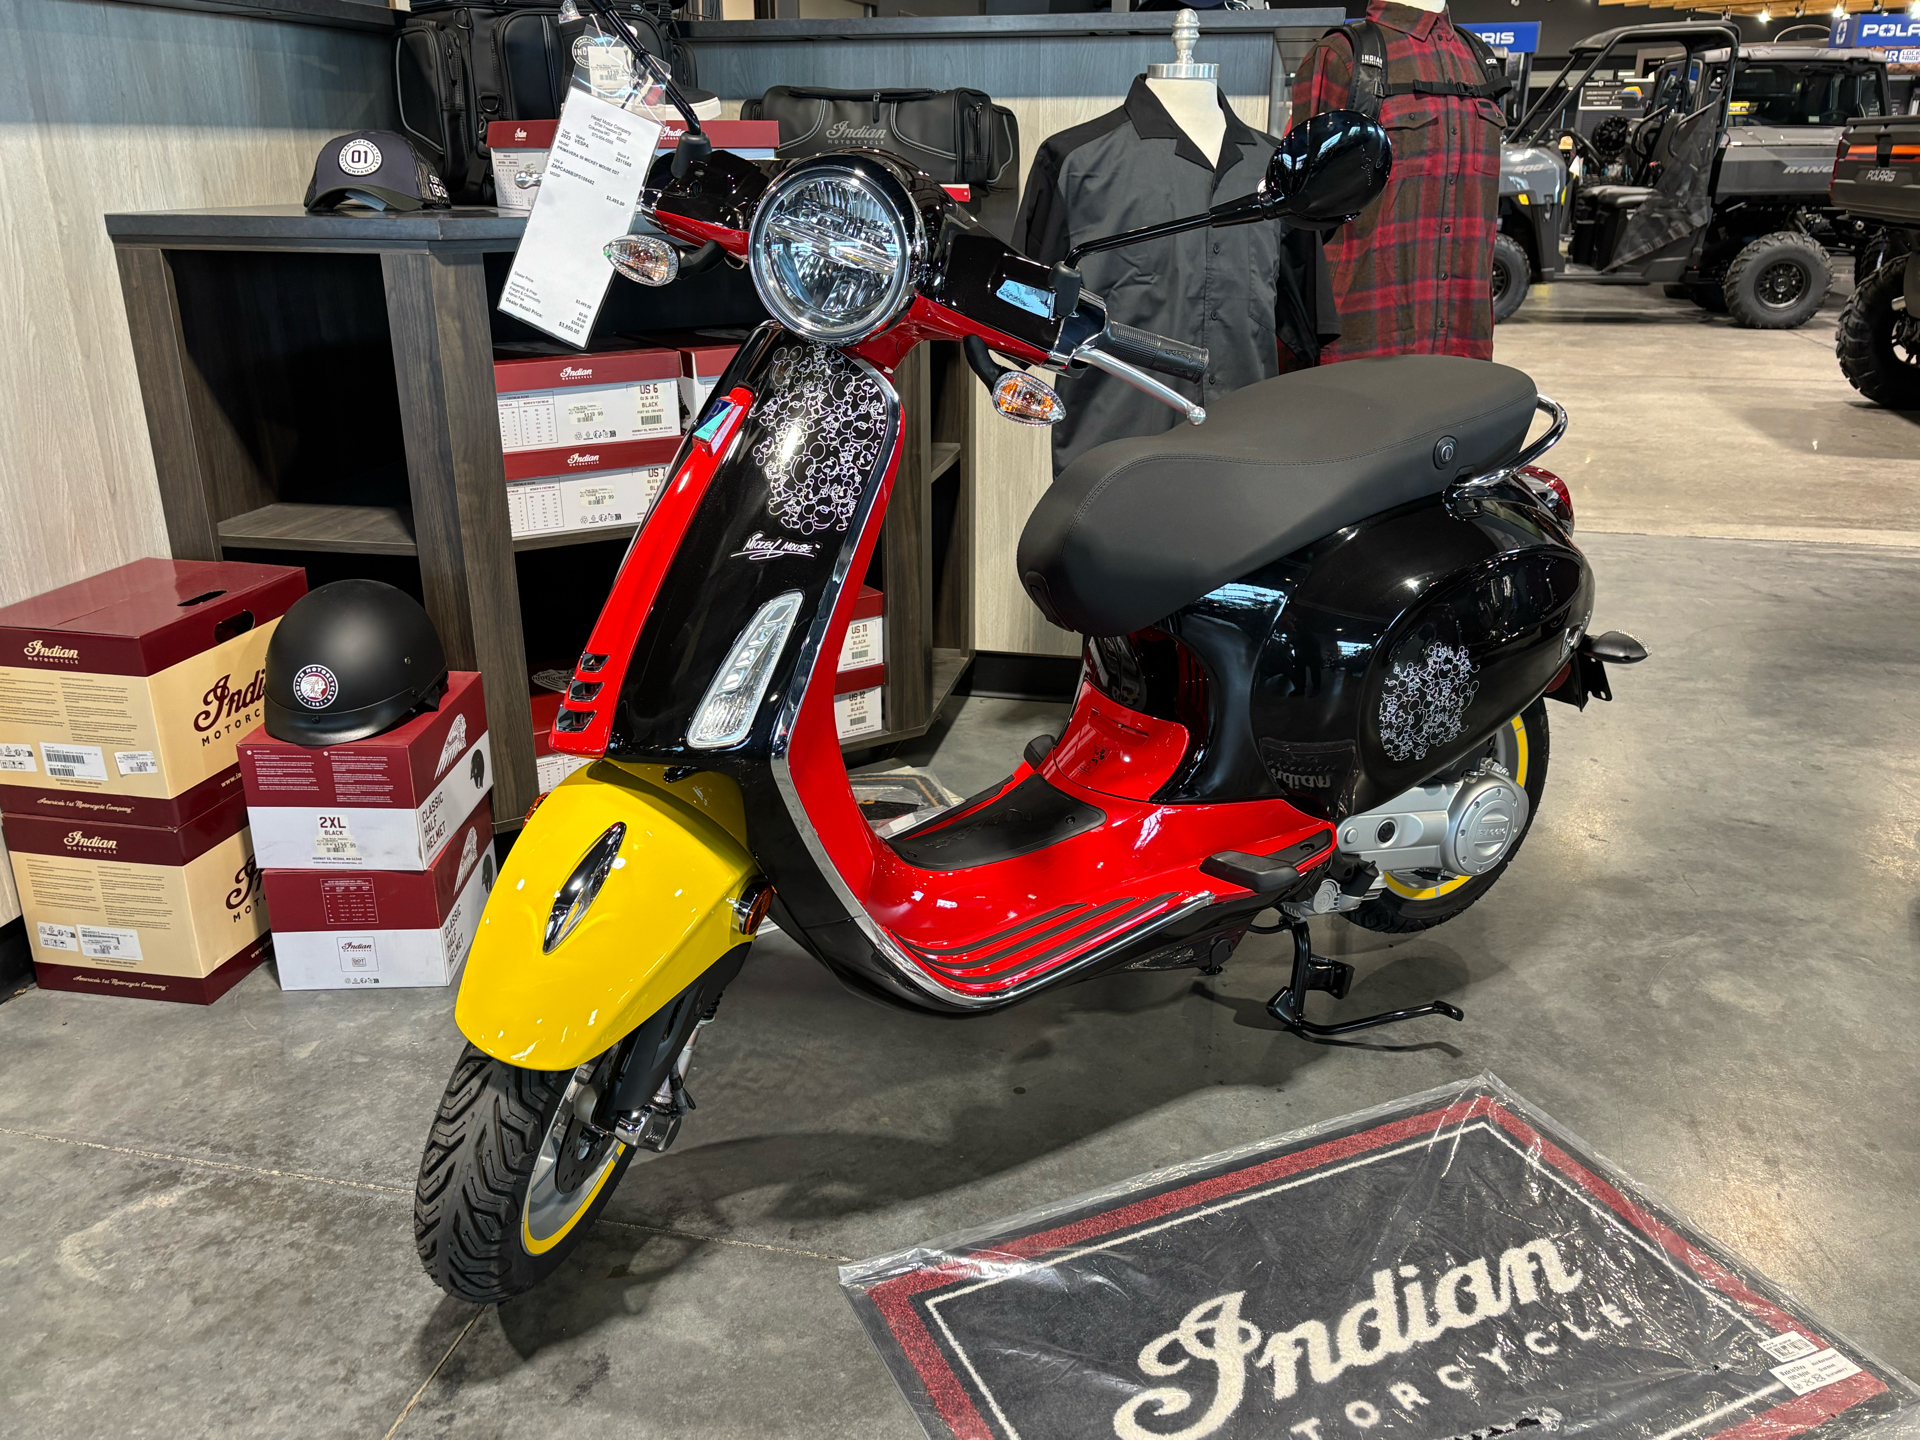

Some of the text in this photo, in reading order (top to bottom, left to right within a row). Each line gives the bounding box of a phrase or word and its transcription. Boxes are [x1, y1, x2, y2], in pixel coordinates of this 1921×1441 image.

[612, 124, 631, 136] Company
[826, 120, 887, 139] Indian
[558, 139, 569, 147] Model
[574, 138, 589, 148] VESPA
[351, 150, 368, 164] 01
[556, 145, 578, 157] PRIMAVERA
[583, 157, 598, 166] MICKEY
[598, 163, 611, 172] MOUSE
[1865, 169, 1897, 183] POLARIS
[505, 297, 518, 306] Dealer
[518, 303, 531, 312] Retail
[560, 366, 593, 378] Indian
[640, 384, 658, 394] US 6
[567, 453, 600, 463] Indian
[648, 468, 659, 477] US
[852, 624, 867, 634] US 11
[24, 640, 78, 659] Indian
[306, 667, 335, 699] MOTORCYCLE
[860, 691, 865, 699] 12
[421, 791, 444, 824] CLASSIC
[319, 817, 346, 828] 2XL
[424, 814, 437, 839] HALF
[63, 831, 117, 849] Indian
[426, 820, 446, 854] HELMET
[67, 846, 116, 854] MOTORCYCLE
[444, 903, 462, 939] CLASSIC
[341, 941, 372, 950] Indian
[446, 928, 457, 954] HALF
[1113, 1237, 1584, 1441] Indian
